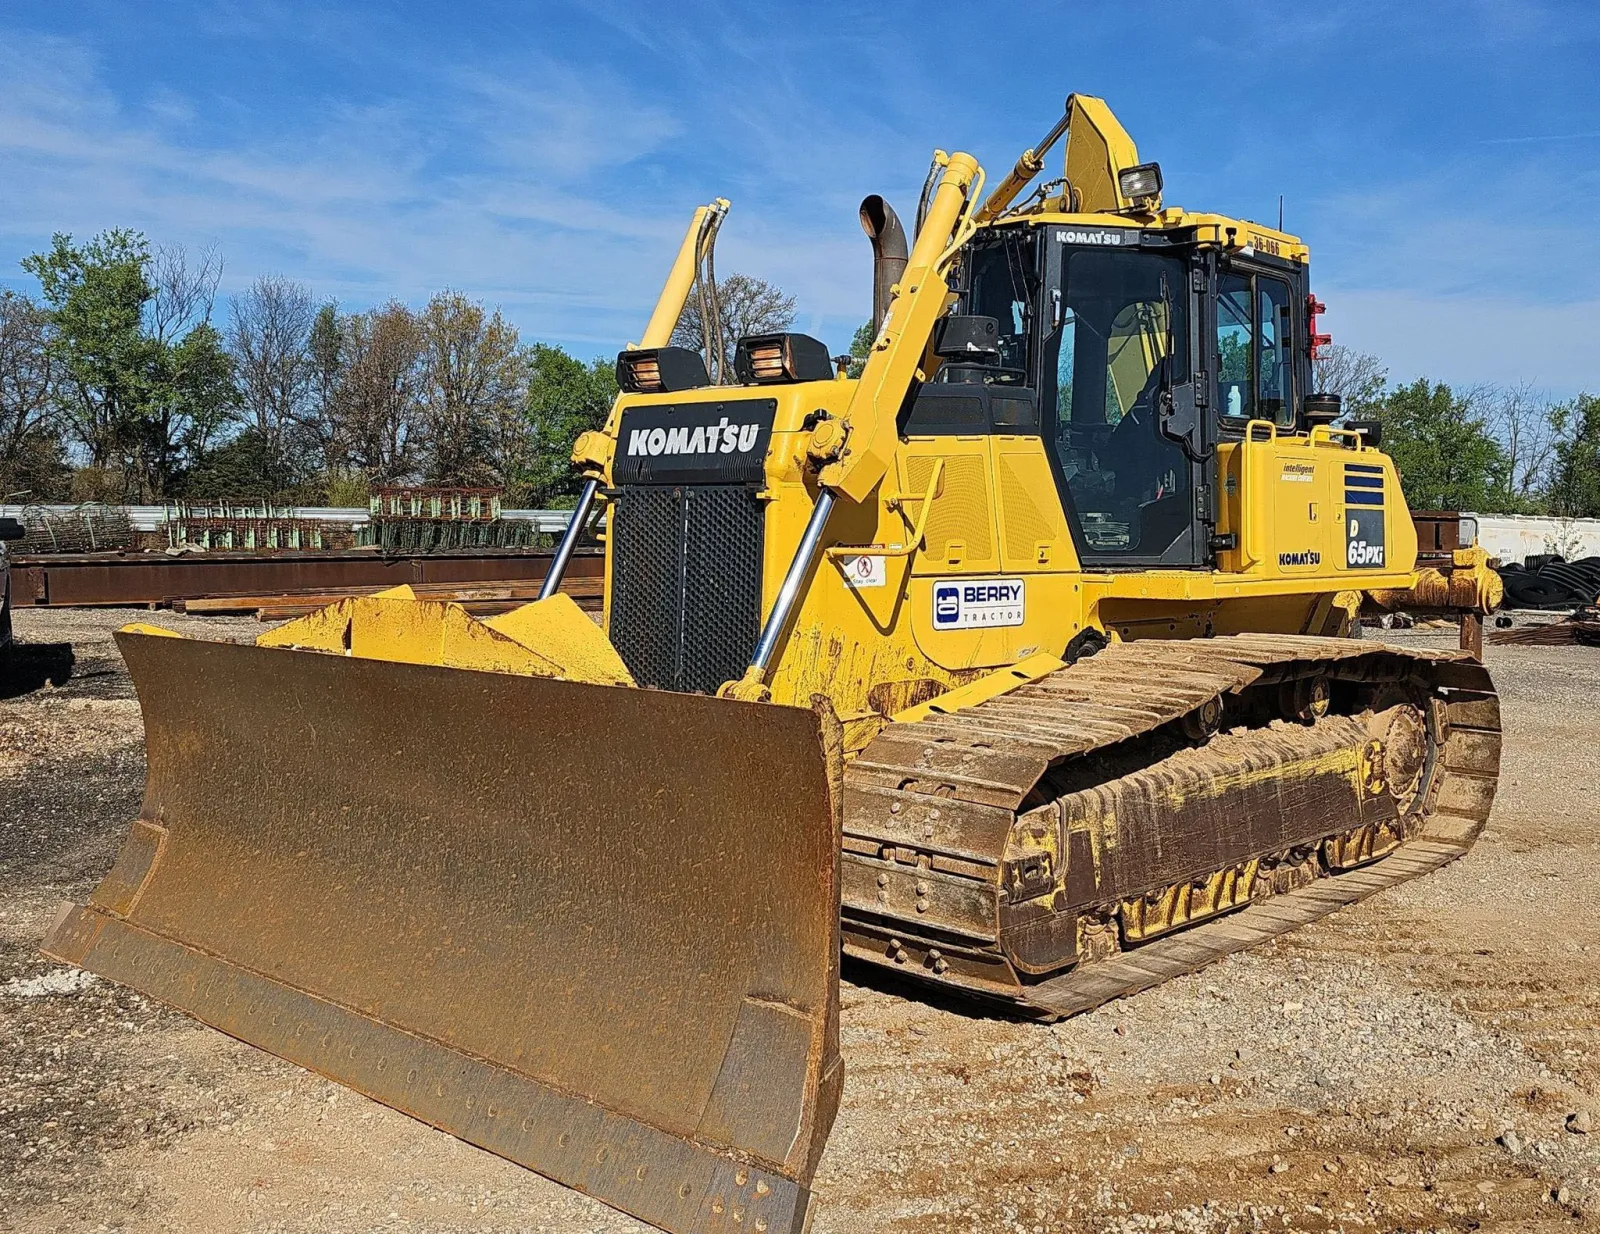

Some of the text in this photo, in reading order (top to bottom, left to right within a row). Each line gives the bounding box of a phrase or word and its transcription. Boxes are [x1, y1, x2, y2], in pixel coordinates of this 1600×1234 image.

[1056, 230, 1121, 245] KOMATSU
[1254, 235, 1280, 256] 36-066
[627, 417, 760, 456] KOMATSU
[1283, 462, 1315, 475] intelligent
[1349, 519, 1359, 537] D
[1279, 549, 1320, 566] KOMATSU
[1347, 540, 1384, 565] 65PXi
[963, 584, 1022, 603] BERRY
[963, 611, 1022, 622] TRACTOR
